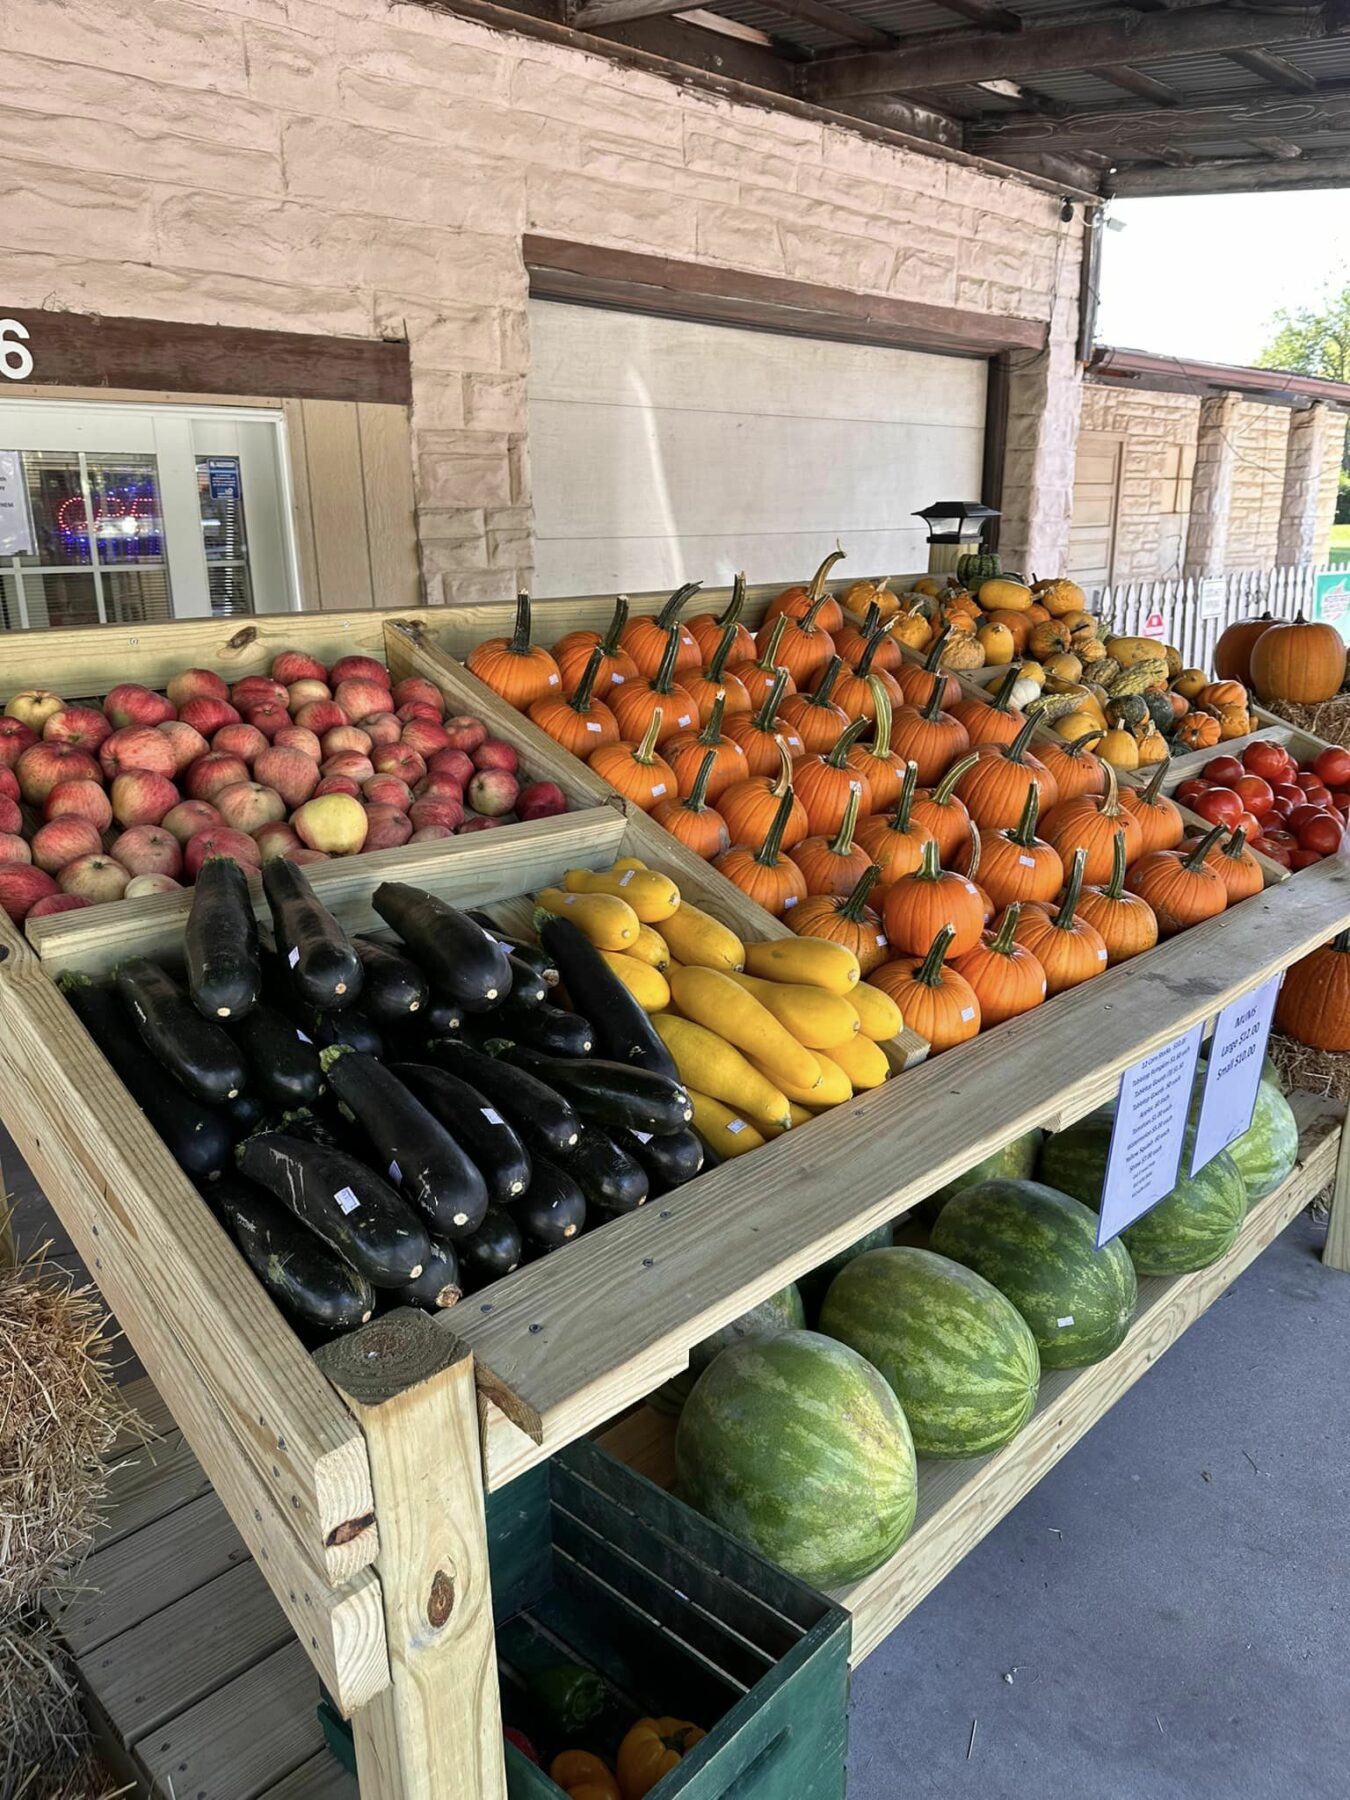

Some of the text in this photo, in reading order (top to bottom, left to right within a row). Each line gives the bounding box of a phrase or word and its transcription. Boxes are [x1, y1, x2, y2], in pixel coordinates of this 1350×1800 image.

[0, 318, 34, 380] 6
[59, 497, 153, 532] OPE
[1234, 1005, 1257, 1028] MUMS
[1221, 1022, 1260, 1057] Large $12.00
[1217, 1044, 1256, 1080] Small $10.00
